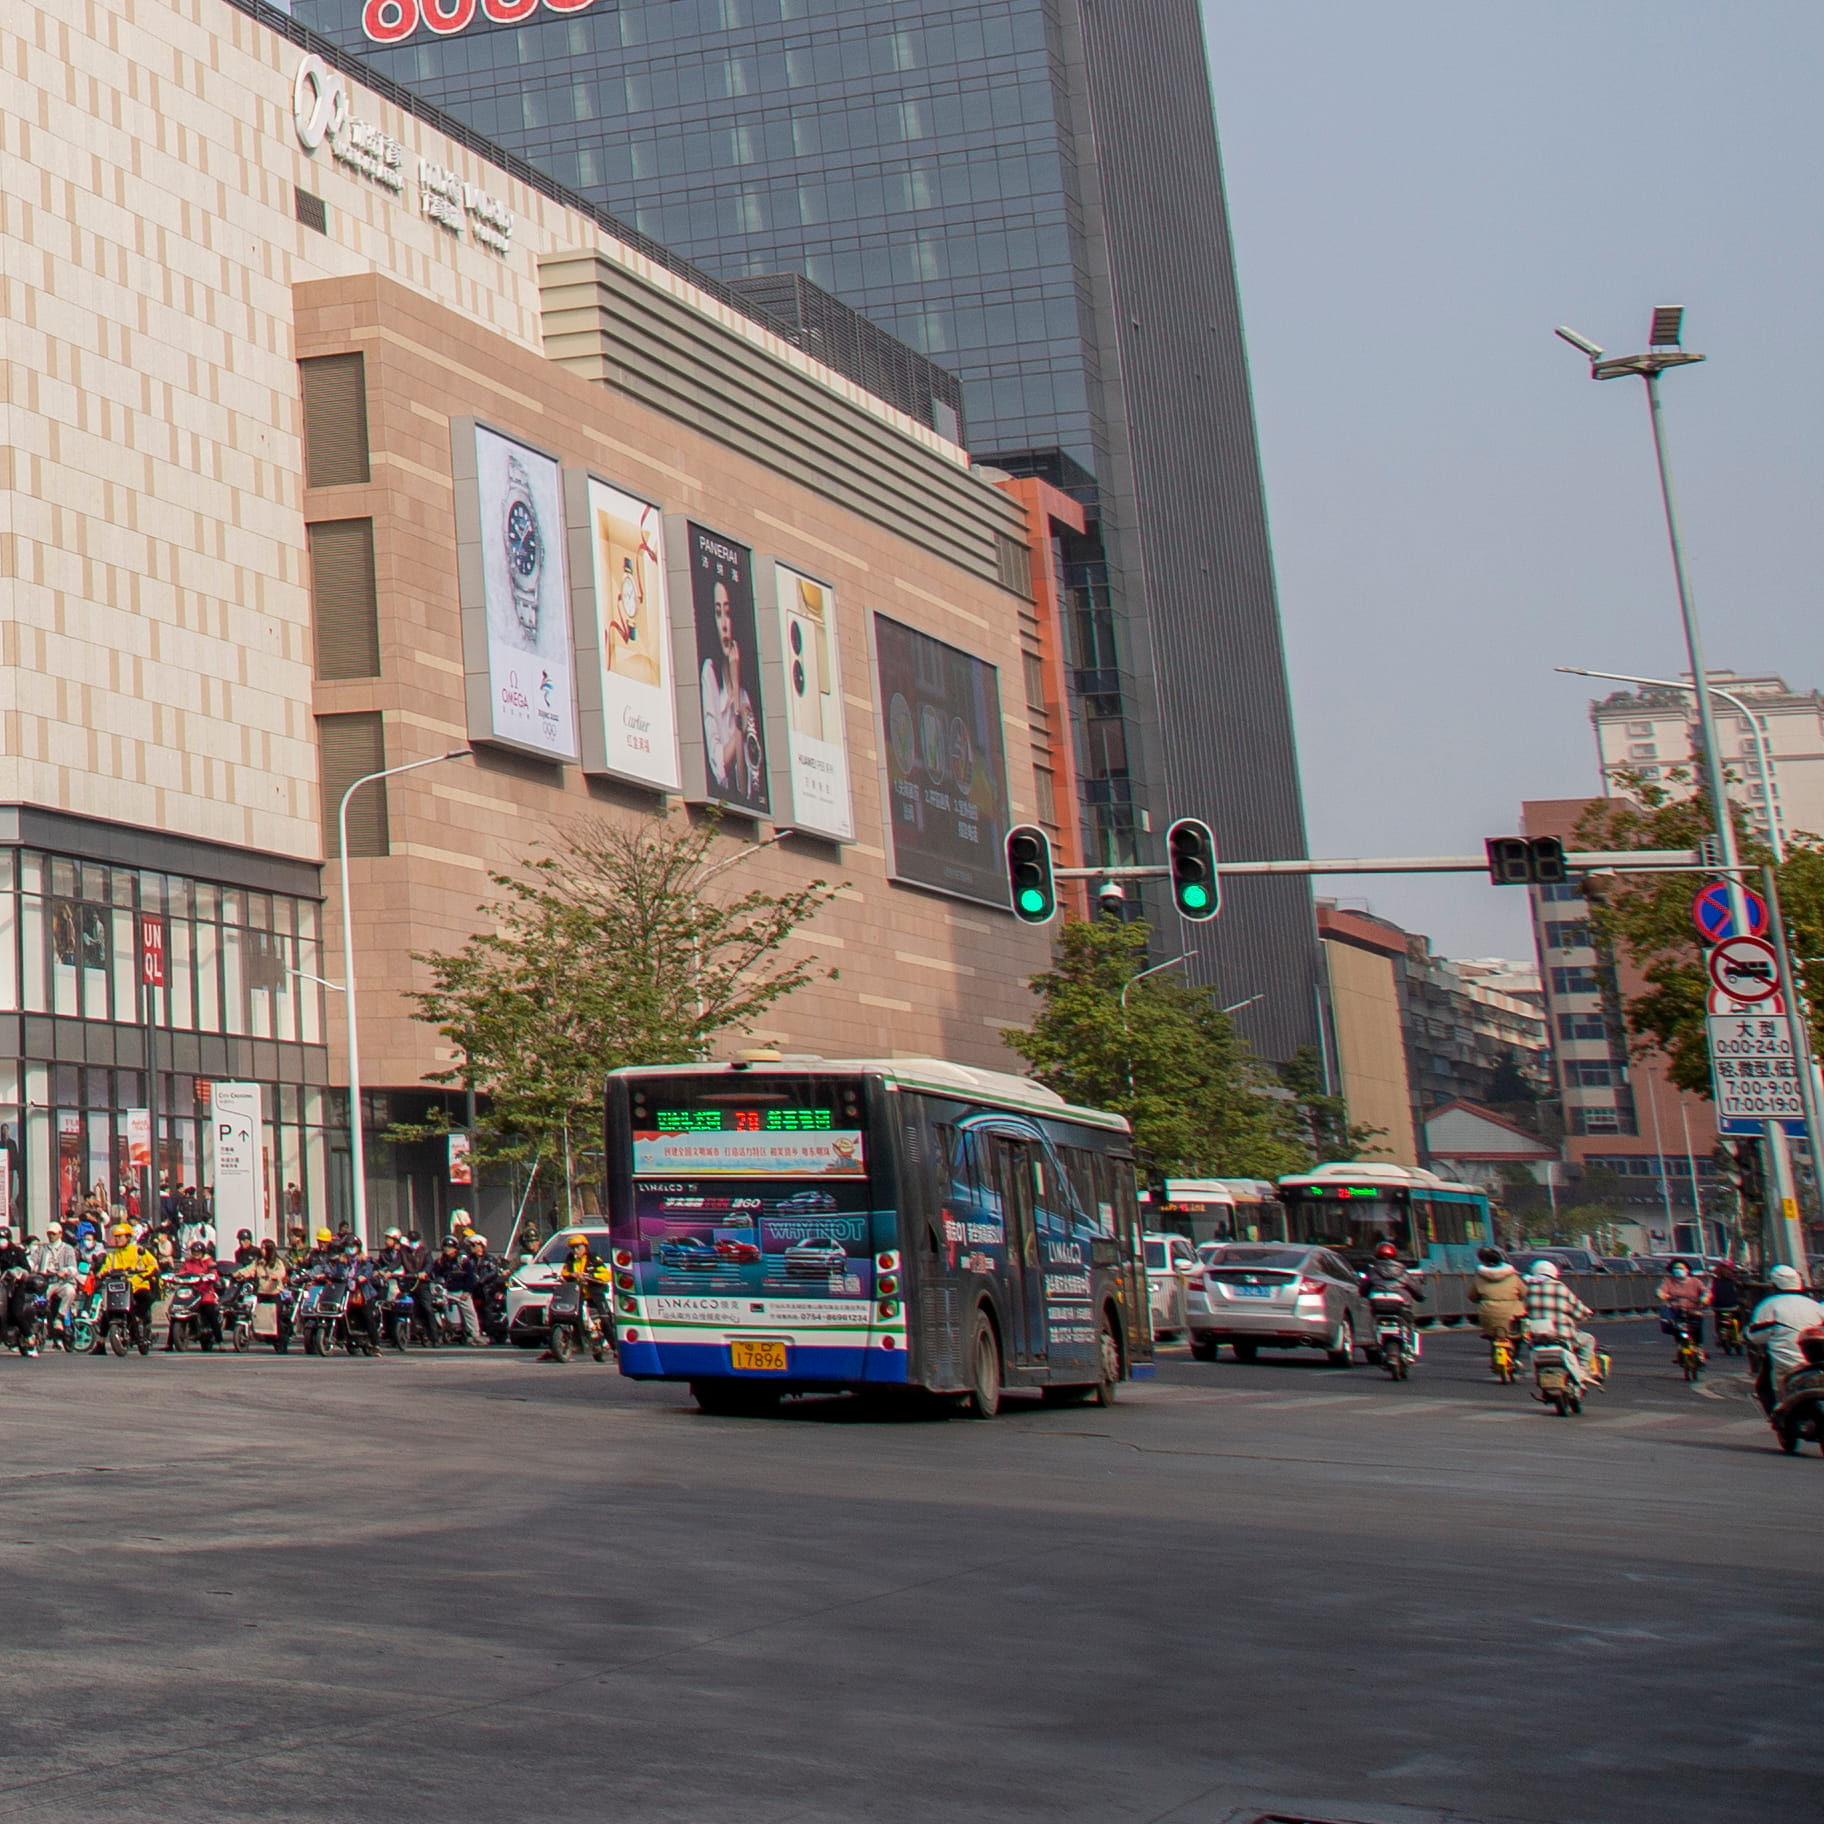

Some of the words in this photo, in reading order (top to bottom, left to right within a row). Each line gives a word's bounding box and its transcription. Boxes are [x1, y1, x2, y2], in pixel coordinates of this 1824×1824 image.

[699, 536, 738, 565] PANERAI
[502, 688, 528, 708] OMEGA
[623, 704, 651, 733] Cartier
[1736, 1020, 1777, 1037] 大型
[1716, 1039, 1791, 1054] 0:00-24:0
[1725, 1097, 1799, 1112] 17:00-19:0
[219, 1124, 232, 1142] P
[736, 1353, 784, 1369] 17896
